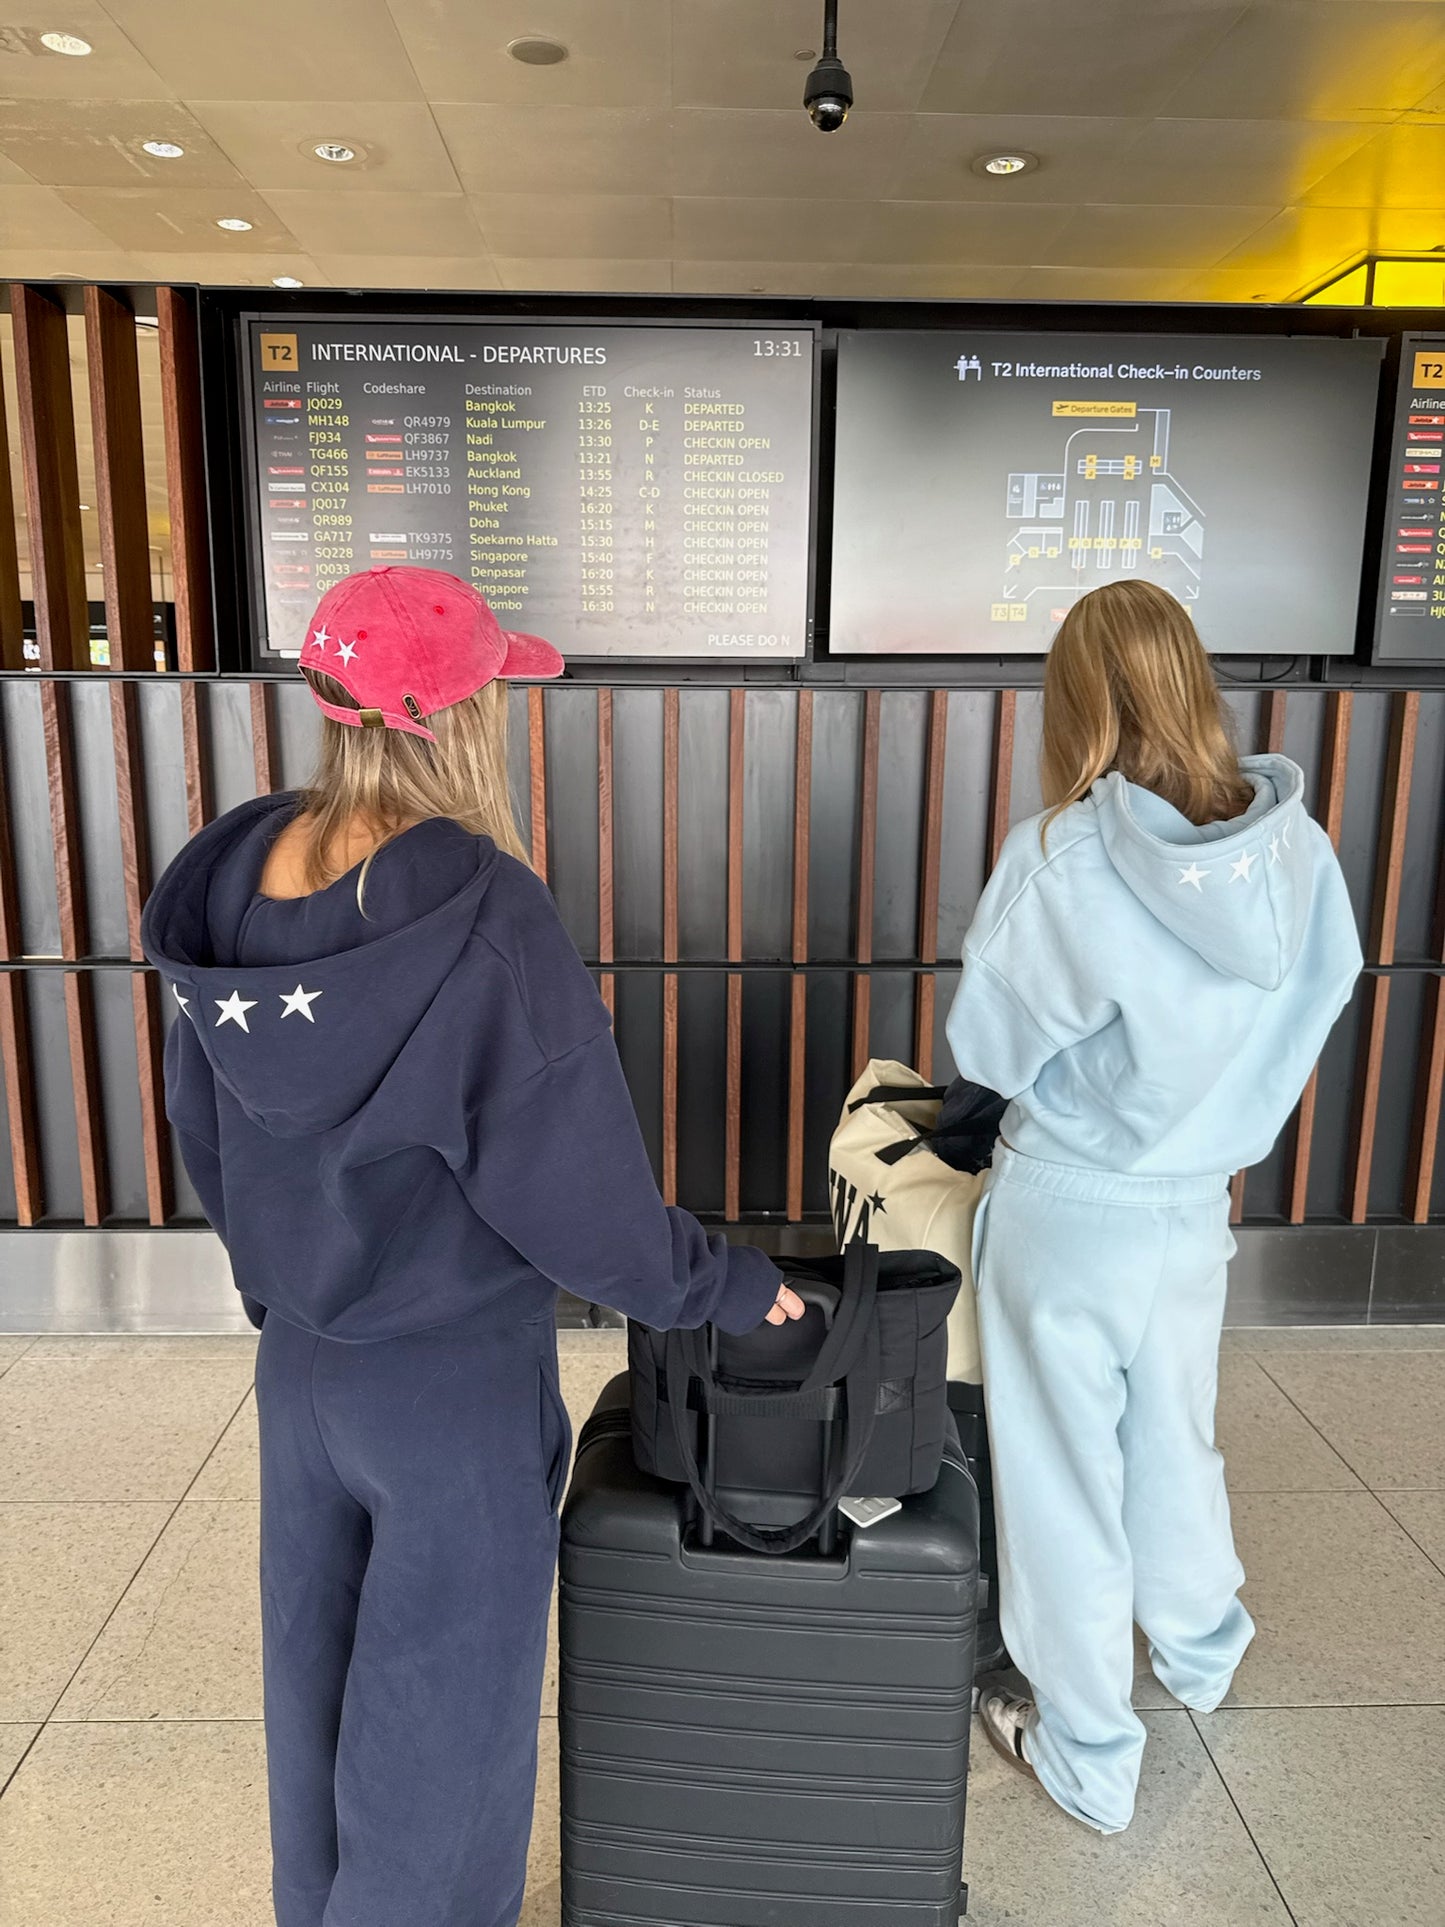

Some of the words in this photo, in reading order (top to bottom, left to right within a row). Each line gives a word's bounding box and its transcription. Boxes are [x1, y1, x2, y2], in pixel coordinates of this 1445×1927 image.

[268, 346, 292, 360] T2
[753, 341, 802, 356] 13:31
[312, 344, 464, 362] INTERNATIONAL
[483, 346, 606, 365] DEPARTURES
[992, 362, 1012, 376] T2
[1016, 363, 1114, 378] International
[1192, 366, 1261, 380] Counters
[1421, 364, 1442, 378] T2
[263, 382, 300, 392] Airline
[307, 382, 339, 395] Flight
[363, 382, 425, 394] Codeshare
[465, 384, 531, 396] Destination
[583, 386, 606, 397] ETD
[624, 386, 674, 398] Check-in
[684, 387, 720, 398] Status
[307, 398, 342, 411] JQ029
[465, 401, 515, 414] Bangkok
[579, 403, 611, 413] 13:25
[645, 404, 653, 414] K
[1071, 404, 1108, 414] Departure
[1110, 406, 1132, 414] Gates
[1410, 398, 1445, 409] Airline
[684, 404, 744, 415] DEPARTED
[308, 416, 349, 426] MH148
[404, 417, 451, 428] QR4979
[466, 418, 498, 429] Kuala
[501, 419, 546, 431] Lumpur
[579, 419, 611, 430] 13:26
[639, 420, 659, 431] D-E
[684, 421, 744, 432] DEPARTED
[309, 432, 341, 444] FJ934
[404, 433, 449, 445] QF3867
[467, 435, 492, 446] Nadi
[579, 436, 611, 447] 13:30
[646, 437, 653, 447] P
[684, 438, 734, 449] CHECKIN
[739, 438, 770, 449] OPEN
[310, 449, 348, 459] TG466
[405, 450, 449, 460] LH9737
[467, 451, 516, 464] Bangkok
[579, 453, 611, 464] 13:21
[645, 454, 654, 464] N
[684, 454, 743, 466] DEPARTED
[311, 466, 348, 477] QF155
[406, 467, 450, 478] EK5133
[468, 469, 520, 480] Auckland
[580, 470, 612, 481] 13:55
[646, 471, 654, 481] R
[684, 471, 734, 483] CHECKIN
[738, 472, 784, 483] CLOSED
[312, 483, 349, 493] CX104
[407, 484, 451, 494] LH7010
[468, 486, 498, 497] Hong
[502, 486, 531, 499] Kong
[580, 486, 612, 497] 14:25
[639, 487, 660, 498] C-D
[684, 488, 734, 499] CHECKIN
[737, 488, 769, 499] OPEN
[311, 499, 346, 510] JQ017
[469, 501, 508, 512] Phuket
[580, 503, 612, 514] 16:20
[646, 504, 654, 514] K
[684, 504, 734, 516] CHECKIN
[737, 505, 769, 516] OPEN
[313, 515, 352, 527] QR989
[470, 518, 499, 529] Doha
[581, 519, 612, 530] 15:15
[645, 520, 655, 530] M
[684, 520, 734, 532] CHECKIN
[737, 521, 768, 532] OPEN
[314, 531, 352, 542] GA717
[409, 532, 452, 544] TK9375
[470, 534, 524, 546] Soekarno
[527, 535, 557, 546] Hatta
[581, 536, 613, 547] 15:30
[646, 537, 654, 547] H
[684, 537, 734, 548] CHECKIN
[737, 537, 768, 548] OPEN
[315, 548, 353, 559] SQ228
[409, 549, 453, 560] LH9775
[470, 551, 528, 564] Singapore
[581, 552, 613, 563] 15:40
[647, 553, 653, 563] F
[684, 553, 734, 564] CHECKIN
[737, 553, 768, 565] OPEN
[315, 564, 350, 576] JQ033
[471, 567, 526, 580] Denpasar
[582, 569, 613, 579] 16:20
[646, 570, 654, 579] K
[684, 569, 734, 581] CHECKIN
[736, 570, 767, 581] OPEN
[472, 582, 528, 596] Singapore
[582, 585, 613, 596] 15:55
[647, 586, 654, 596] R
[684, 585, 734, 597] CHECKIN
[736, 586, 767, 597] OPEN
[487, 599, 522, 610] lombo
[582, 601, 614, 612] 16:30
[646, 602, 654, 612] N
[684, 602, 733, 613] CHECKIN
[736, 602, 767, 614] OPEN
[994, 608, 1006, 616] T3
[1012, 608, 1024, 616] T4
[708, 634, 753, 646] PLEASE
[758, 635, 777, 646] DO
